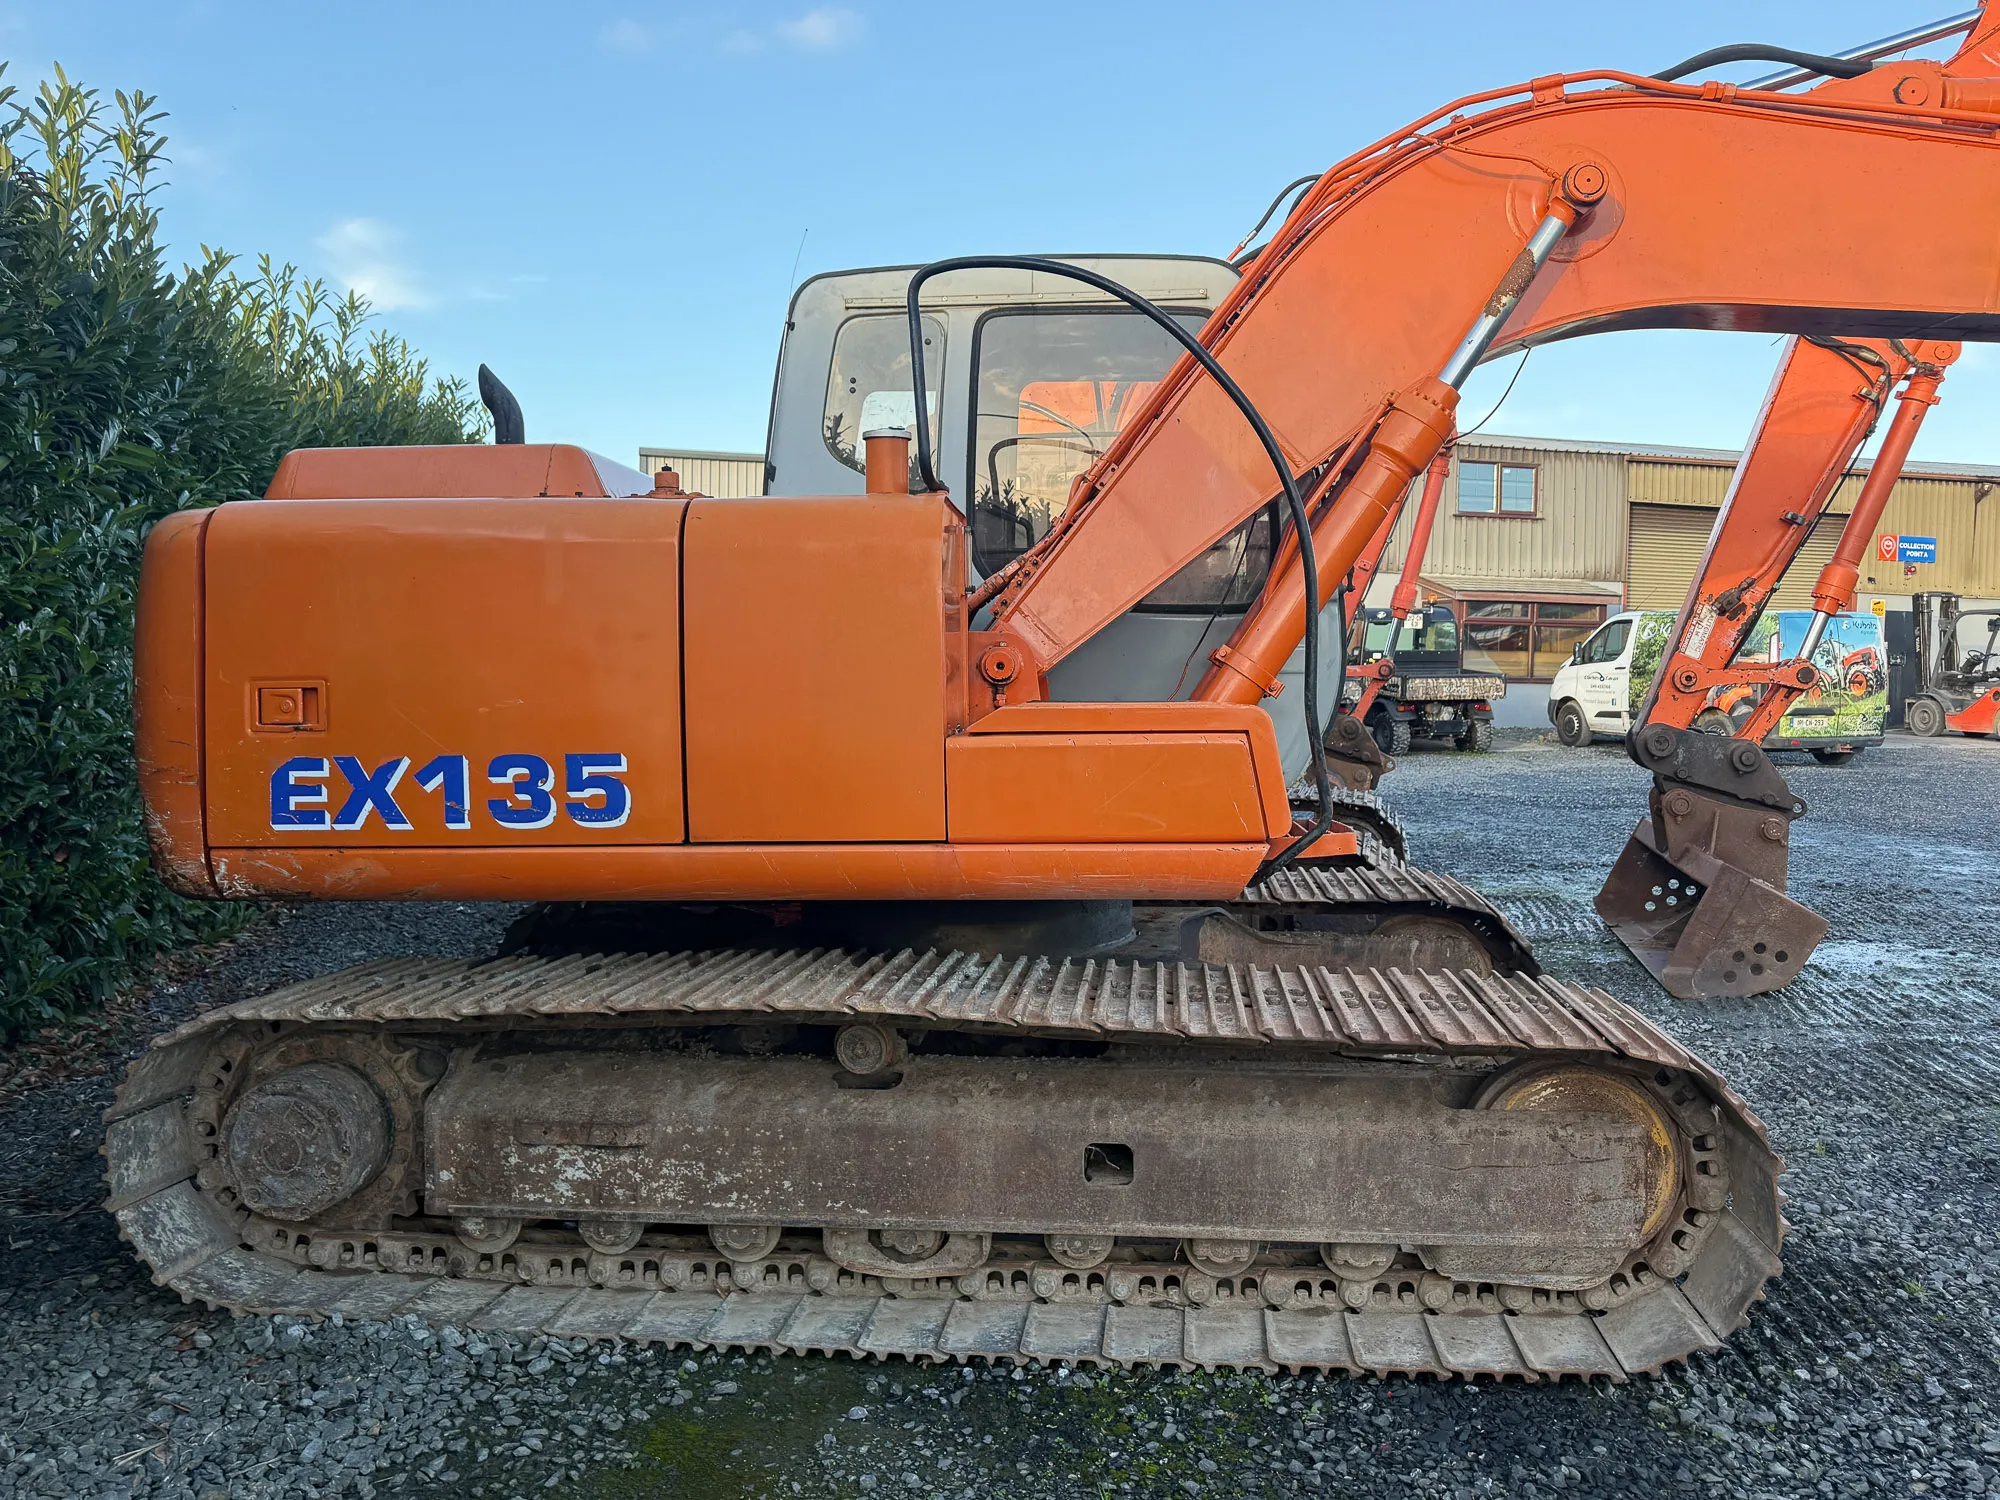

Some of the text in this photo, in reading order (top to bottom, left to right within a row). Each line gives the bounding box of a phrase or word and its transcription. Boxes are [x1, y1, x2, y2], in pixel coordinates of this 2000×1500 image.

[1694, 613, 1714, 653] AUTOMATIC
[1852, 620, 1877, 629] Kubota
[269, 752, 632, 831] EX135
